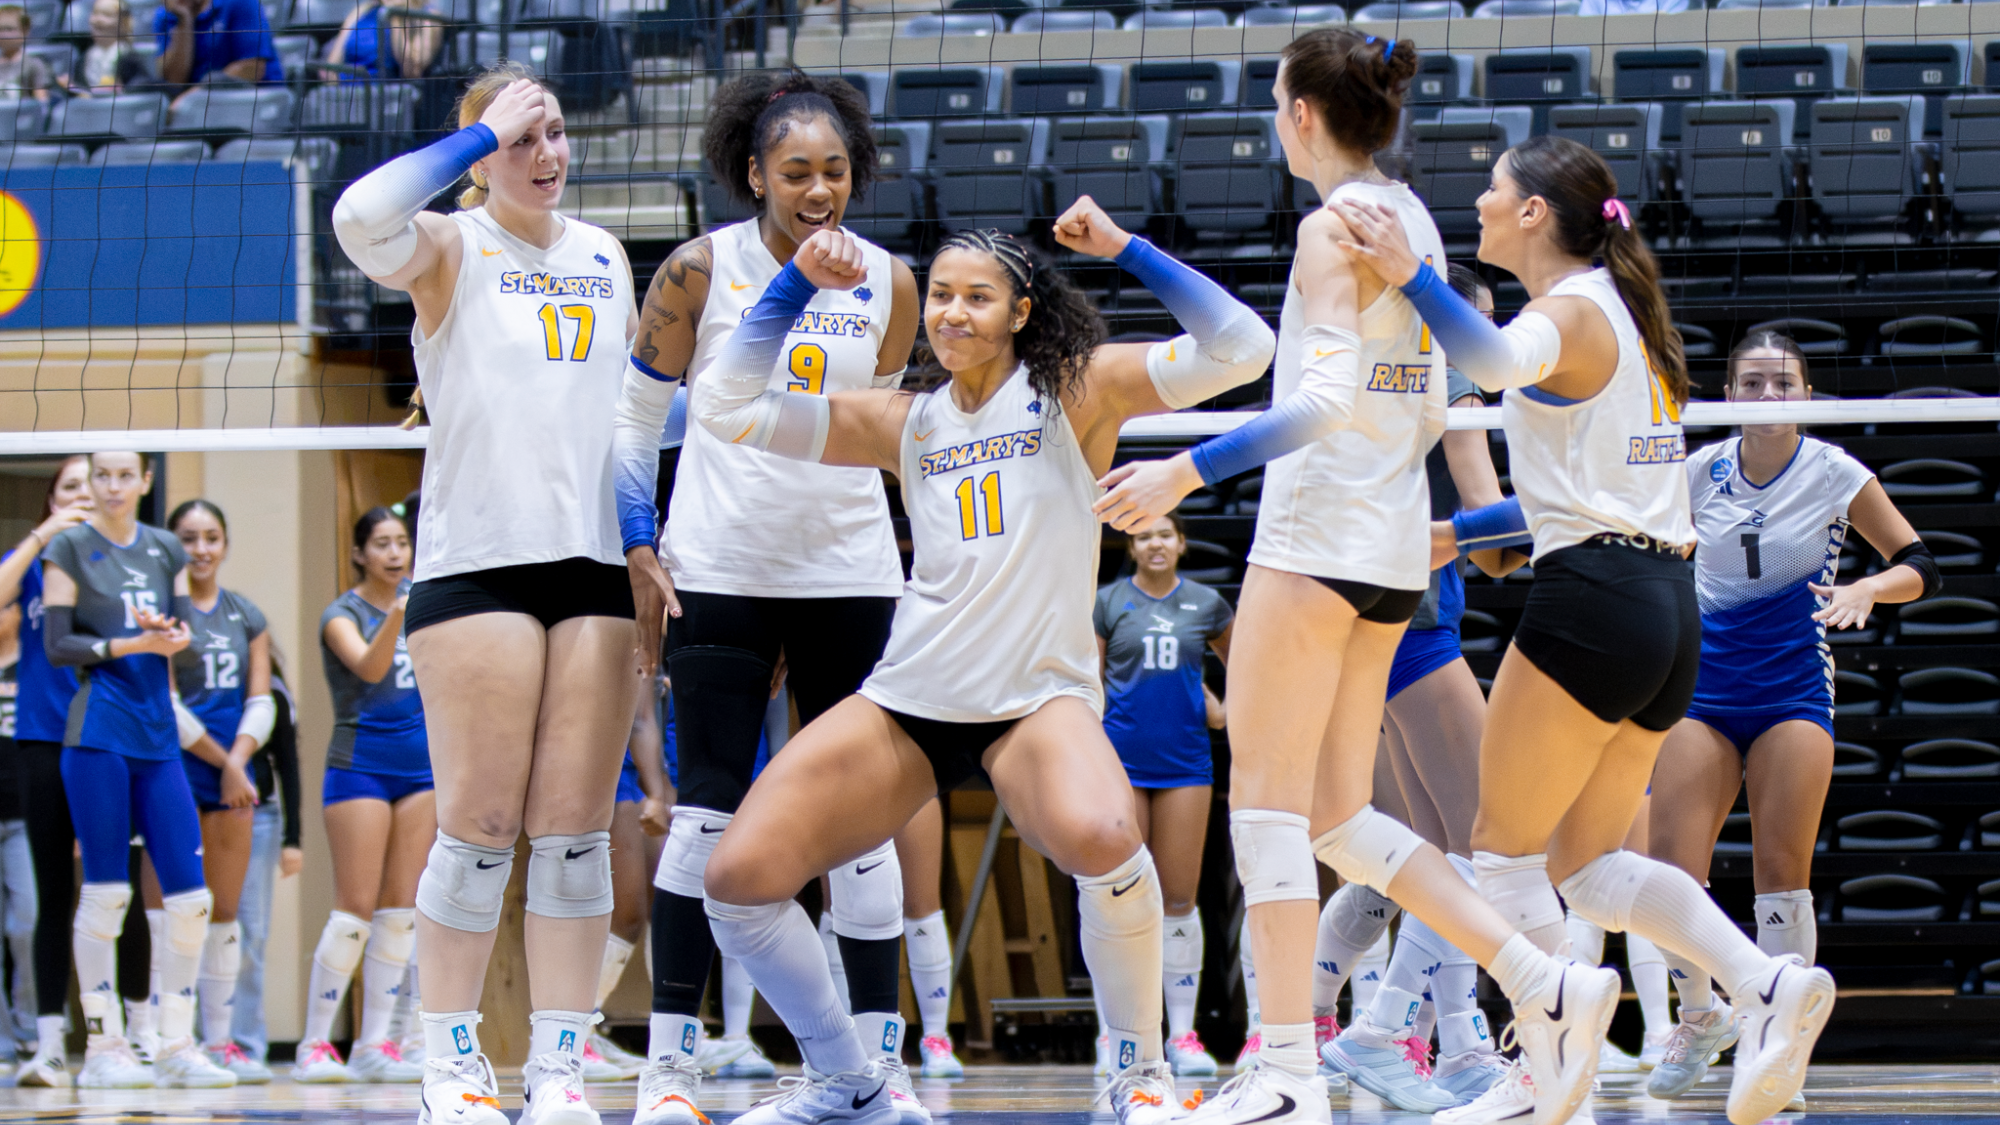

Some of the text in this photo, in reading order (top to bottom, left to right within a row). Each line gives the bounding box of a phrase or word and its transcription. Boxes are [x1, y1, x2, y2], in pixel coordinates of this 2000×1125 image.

[537, 302, 596, 362] 17
[787, 342, 828, 395] 9
[1366, 362, 1432, 393] RATT
[955, 470, 1005, 541] 11
[1740, 533, 1762, 580] 1
[120, 591, 158, 630] 15
[202, 651, 239, 690] 12
[394, 652, 416, 689] 2
[1142, 635, 1179, 671] 18
[658, 1054, 674, 1062] NIKE
